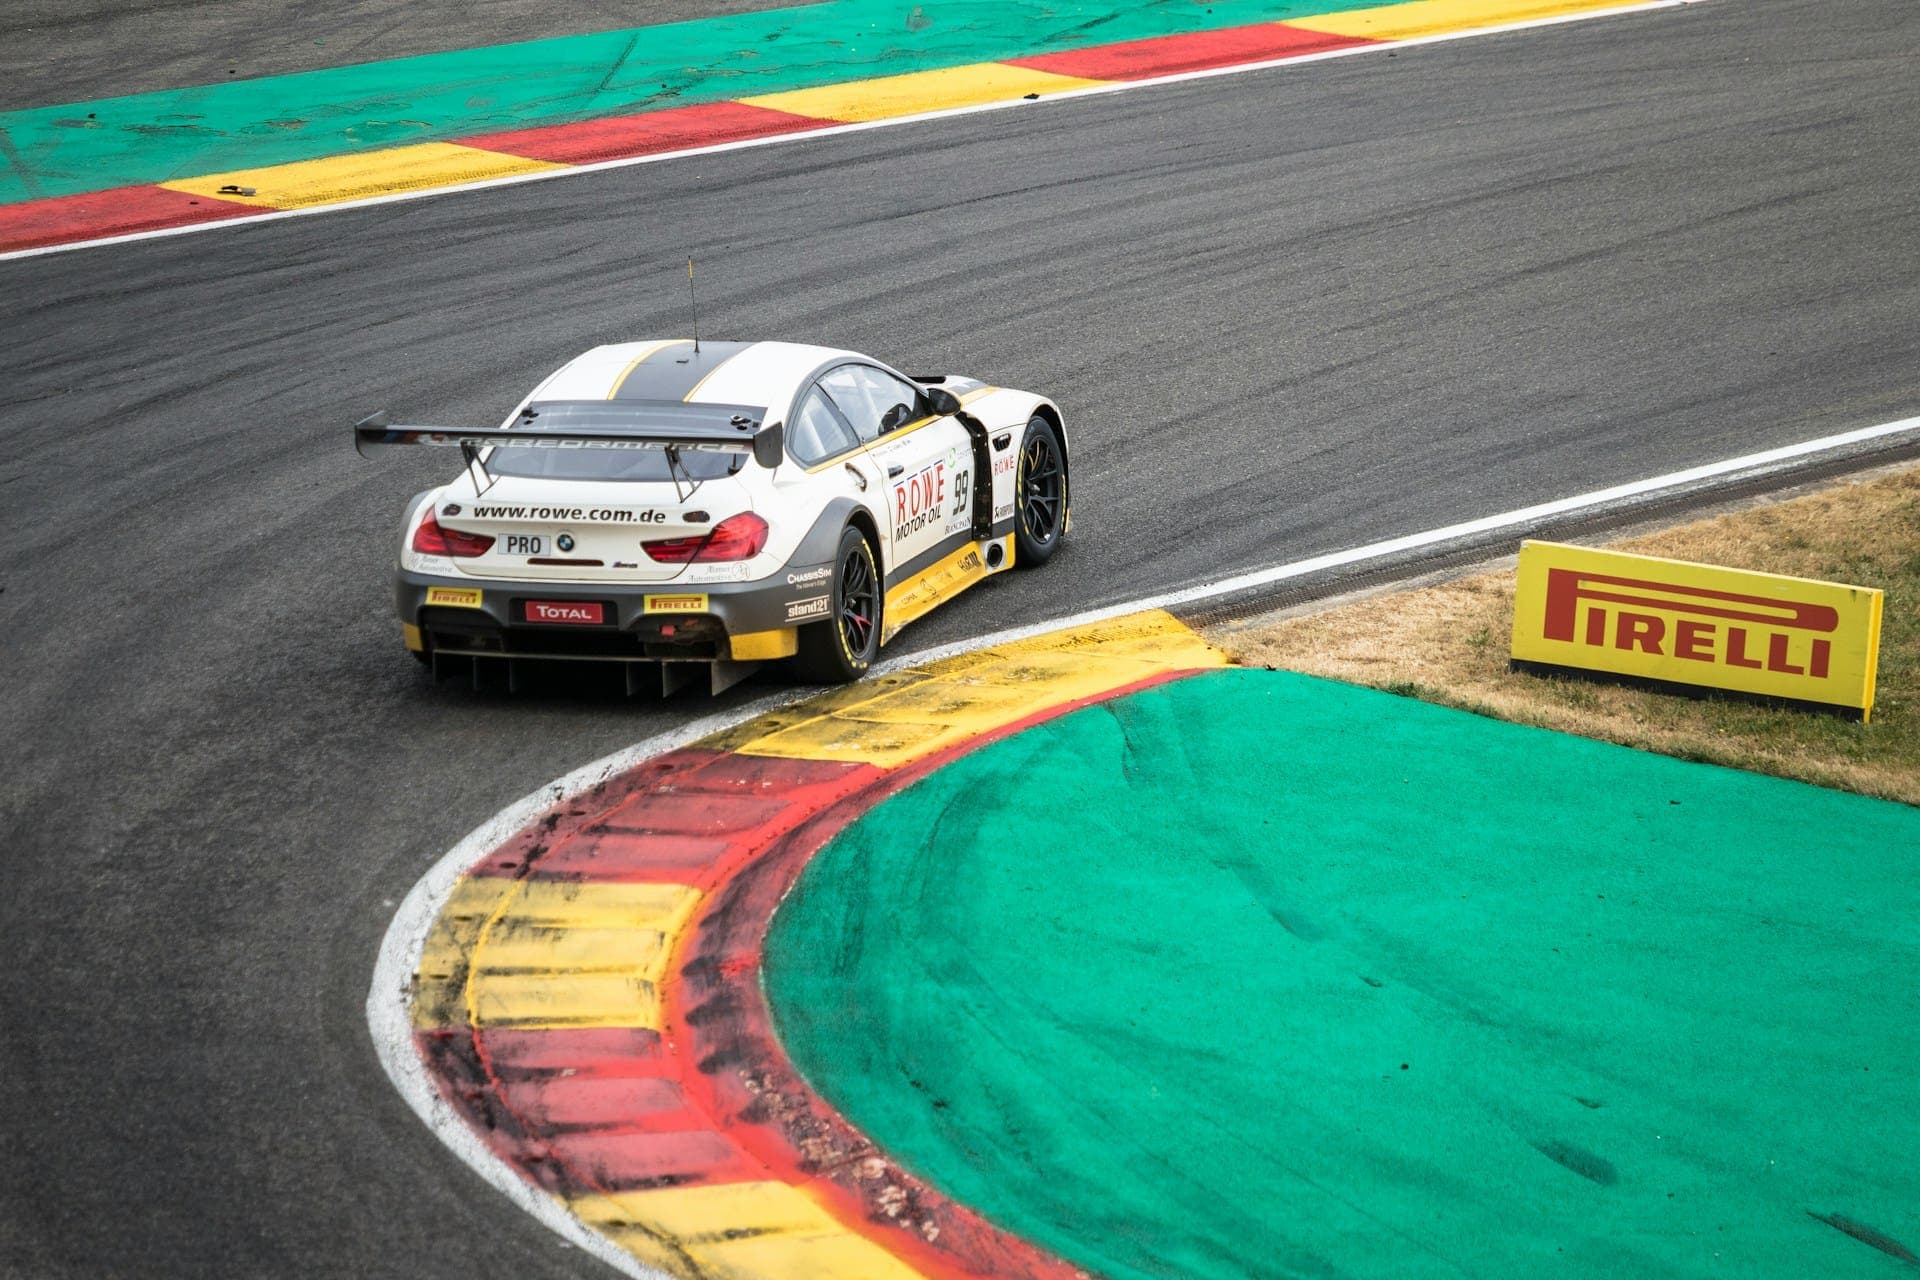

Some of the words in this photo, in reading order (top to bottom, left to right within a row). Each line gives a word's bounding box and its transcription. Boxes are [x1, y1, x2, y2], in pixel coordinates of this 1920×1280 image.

[994, 456, 1015, 475] ROWE
[895, 463, 945, 526] ROWE
[953, 469, 969, 516] 99
[473, 506, 666, 524] www.rowe.com.de
[895, 514, 926, 543] MOTOR
[928, 503, 942, 526] OIL
[507, 535, 541, 554] PRO
[432, 591, 477, 604] PIRELLI
[650, 597, 702, 609] PIRELLI
[536, 605, 592, 619] TOTAL
[788, 598, 828, 617] stand21
[1543, 568, 1839, 678] PIRELLI
